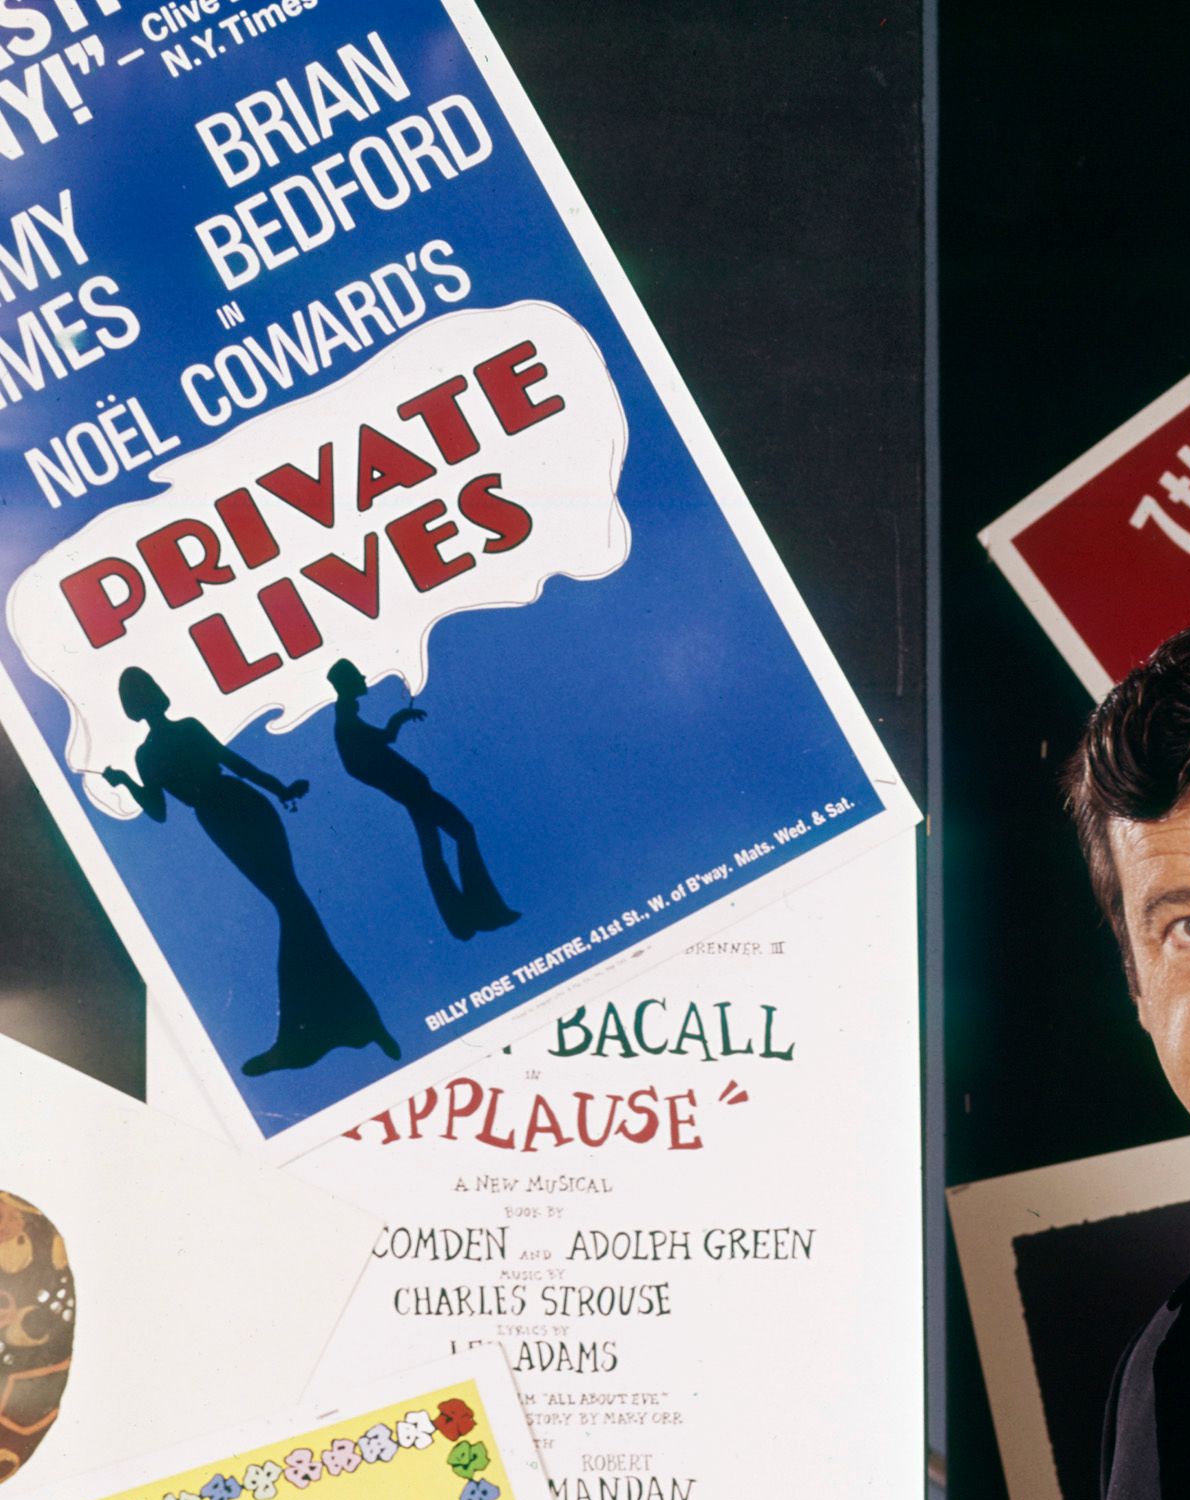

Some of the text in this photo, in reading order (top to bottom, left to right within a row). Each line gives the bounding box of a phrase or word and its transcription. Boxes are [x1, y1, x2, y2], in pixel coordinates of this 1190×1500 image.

[195, 31, 411, 188] BRIAN
[195, 94, 493, 291] BEDFORD
[216, 301, 245, 330] IN
[24, 239, 471, 509] NOËL COWARD'S
[60, 340, 566, 650] PRIVATE
[189, 472, 533, 695] LIVES
[425, 998, 469, 1033] BILLY
[469, 975, 515, 1011] ROSE
[512, 938, 592, 984] THEATRE,
[588, 919, 625, 945] 41st
[647, 893, 671, 914] W.
[670, 882, 689, 902] of
[733, 840, 776, 867] Mats.
[773, 820, 812, 845] Wed.
[811, 809, 827, 828] &
[823, 798, 856, 821] Sat.
[547, 997, 795, 1062] BACALL
[454, 1175, 614, 1194] A NEW MUSICAL
[504, 1206, 564, 1219] BOOK BY
[372, 1226, 817, 1261] COMDEN ADOLPH GREEN
[499, 1268, 566, 1281] MUSIC BY
[393, 1281, 672, 1317] CHARLES STROUSE
[512, 1340, 619, 1374] ADAMS
[579, 1412, 598, 1425] BY
[602, 1411, 648, 1425] MARY
[581, 1453, 654, 1473] ROBERT
